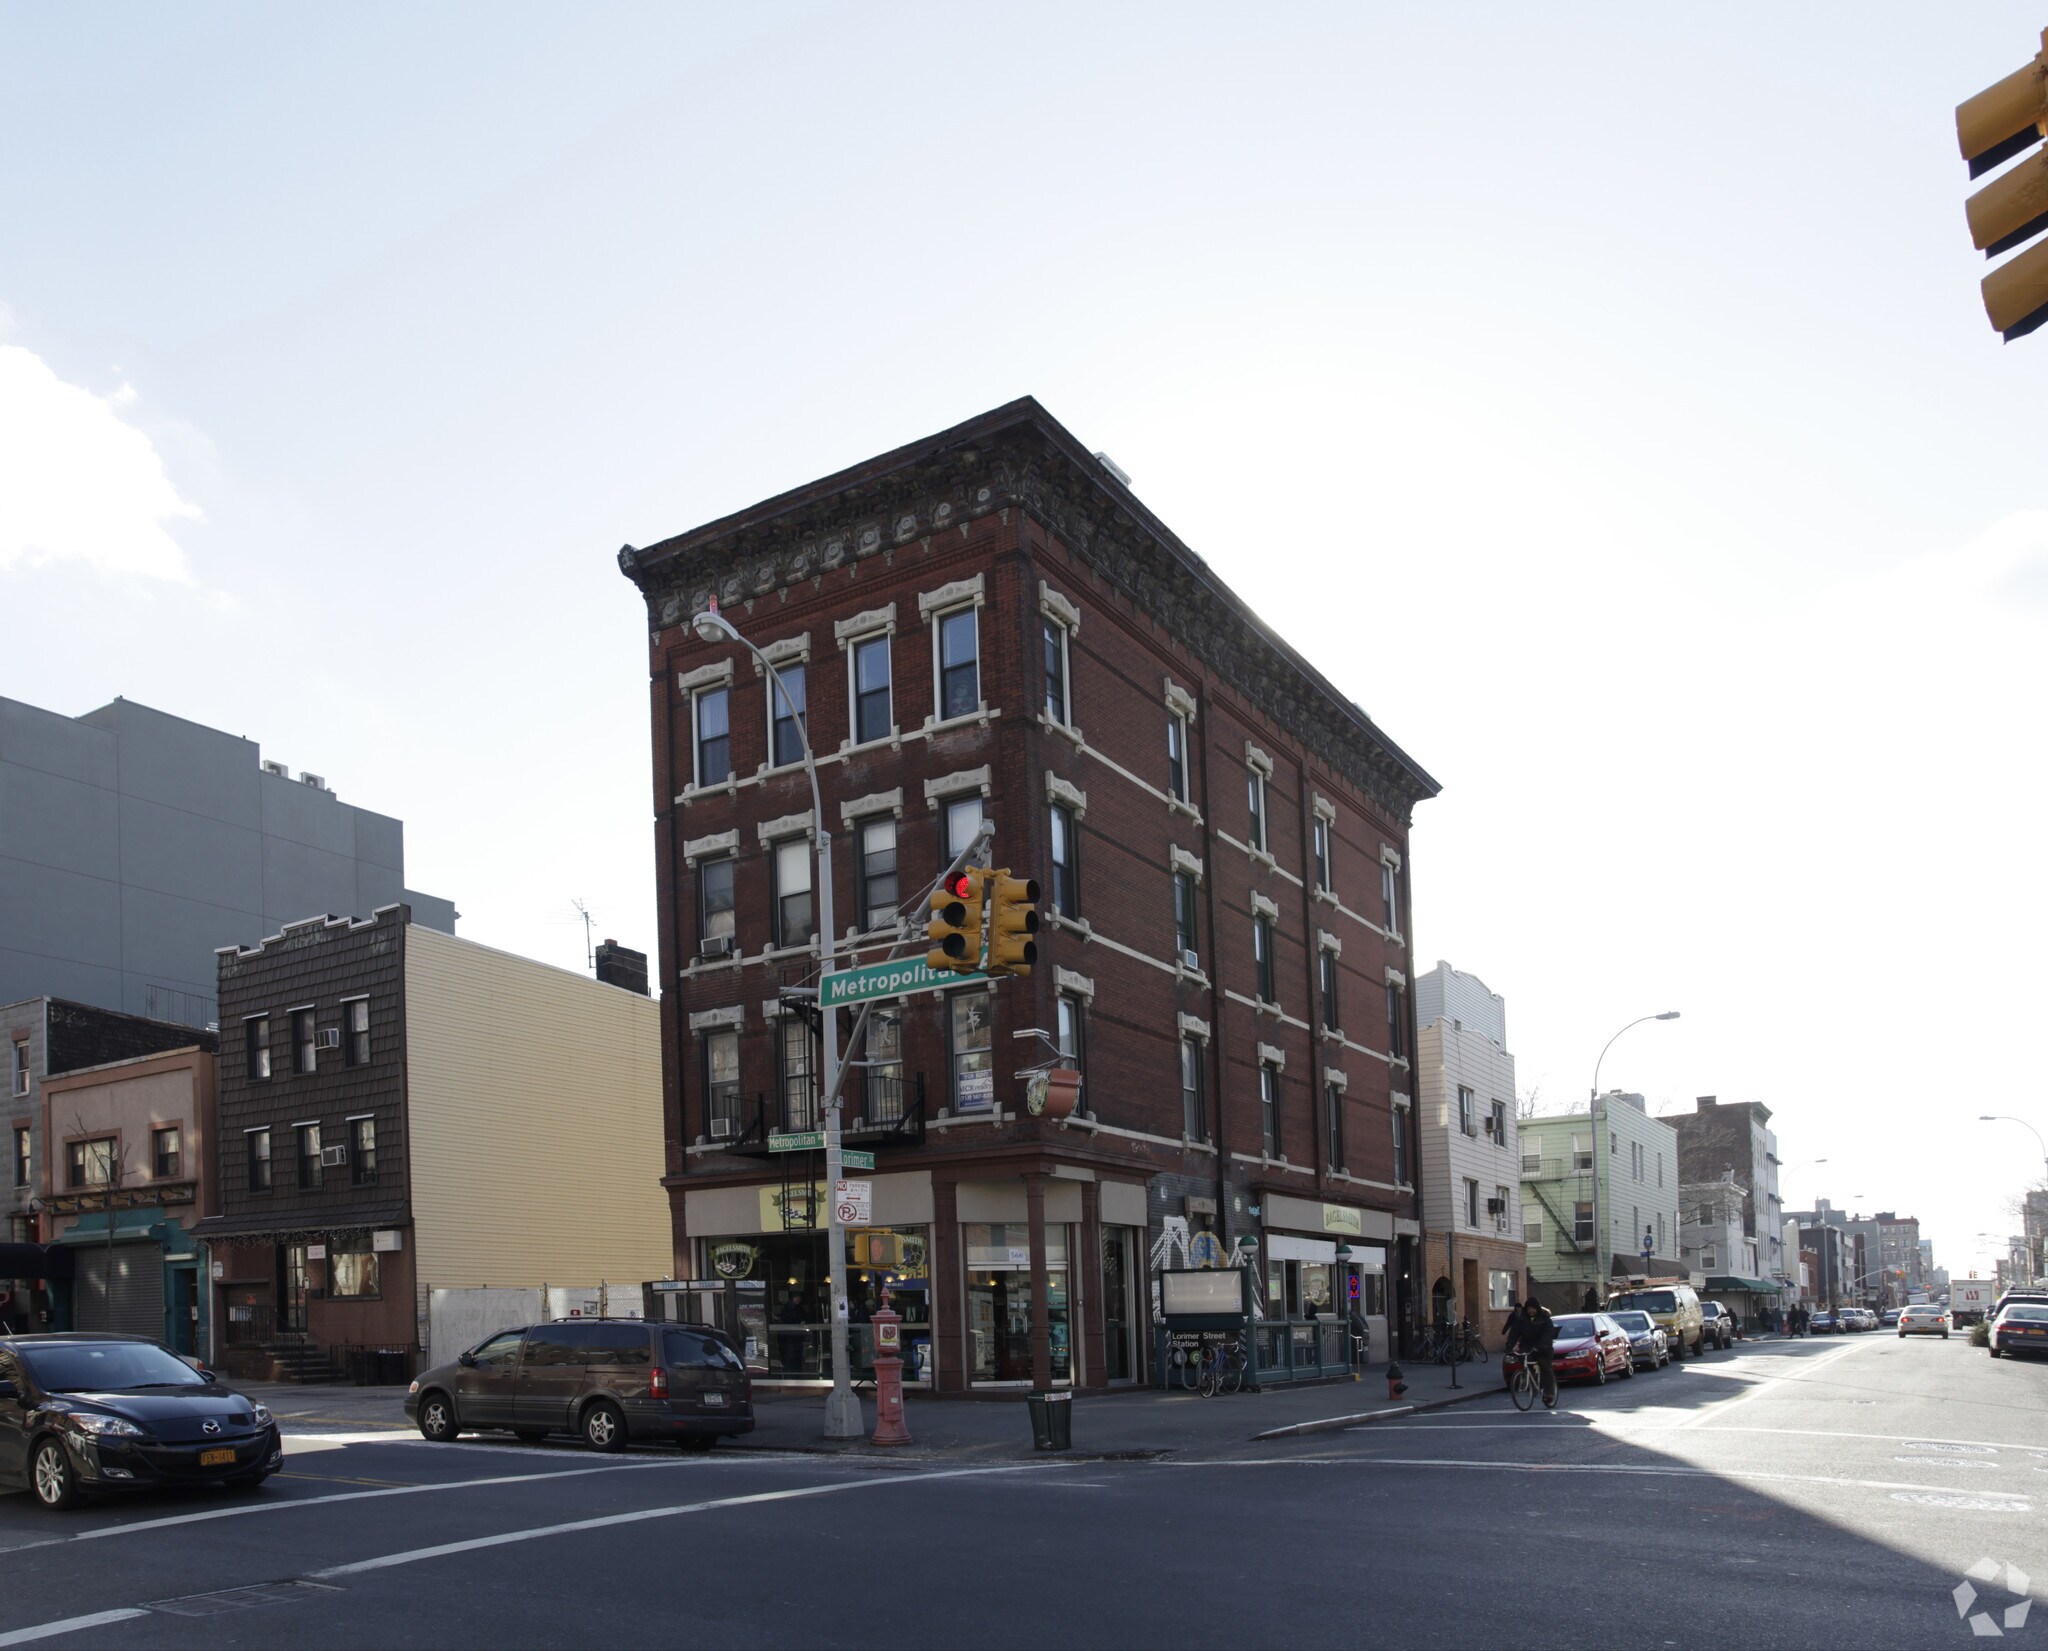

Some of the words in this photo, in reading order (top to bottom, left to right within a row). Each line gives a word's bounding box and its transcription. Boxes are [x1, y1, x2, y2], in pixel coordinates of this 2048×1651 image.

[831, 964, 957, 999] Metropolita
[769, 1135, 816, 1149] Metropolitan
[837, 1181, 847, 1190] NO
[1326, 1209, 1360, 1231] BAGELSMITH
[716, 1244, 751, 1254] BAGELSMITH
[1172, 1332, 1200, 1340] Lorimer
[1202, 1332, 1226, 1340] Street
[1172, 1340, 1199, 1348] Station
